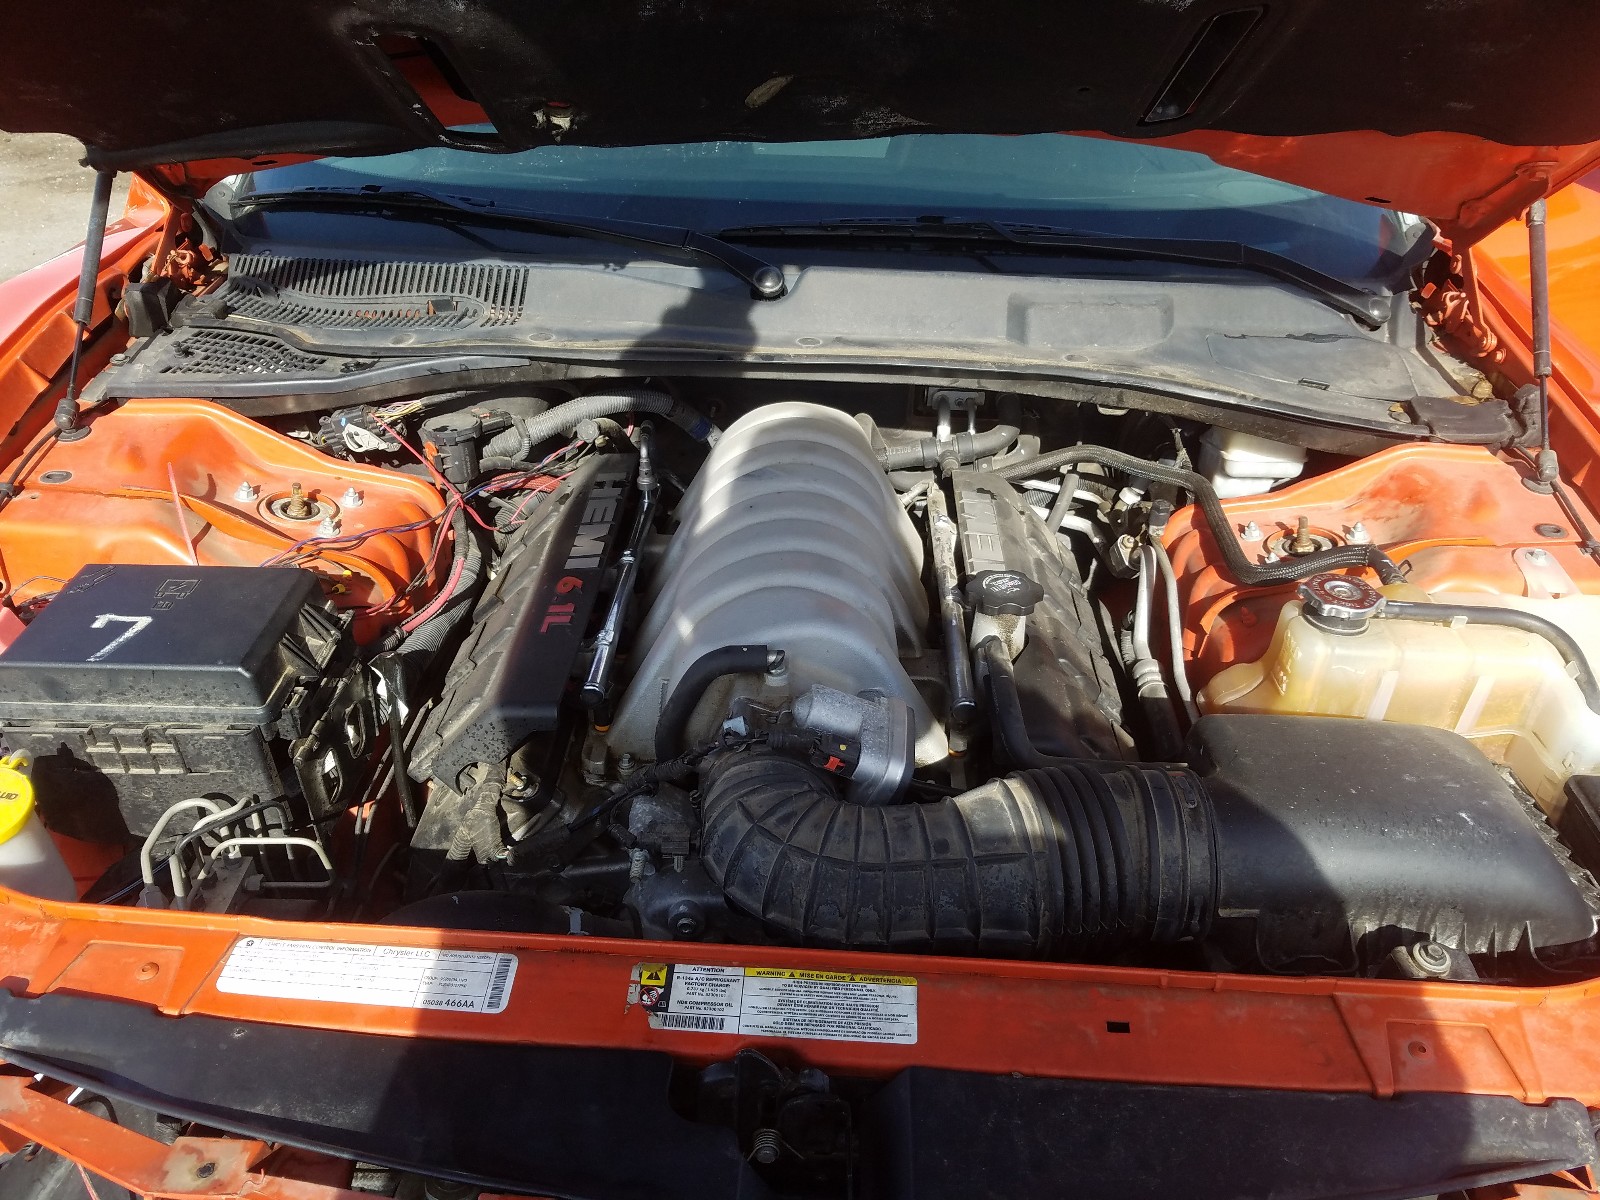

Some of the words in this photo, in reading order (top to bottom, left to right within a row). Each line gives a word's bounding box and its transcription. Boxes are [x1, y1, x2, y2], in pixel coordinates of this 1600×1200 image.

[564, 472, 630, 570] HEMI
[86, 613, 153, 662] 7
[382, 948, 414, 957] Chrysler
[859, 976, 902, 984] ADVERTENCIA
[444, 998, 475, 1008] 466AA
